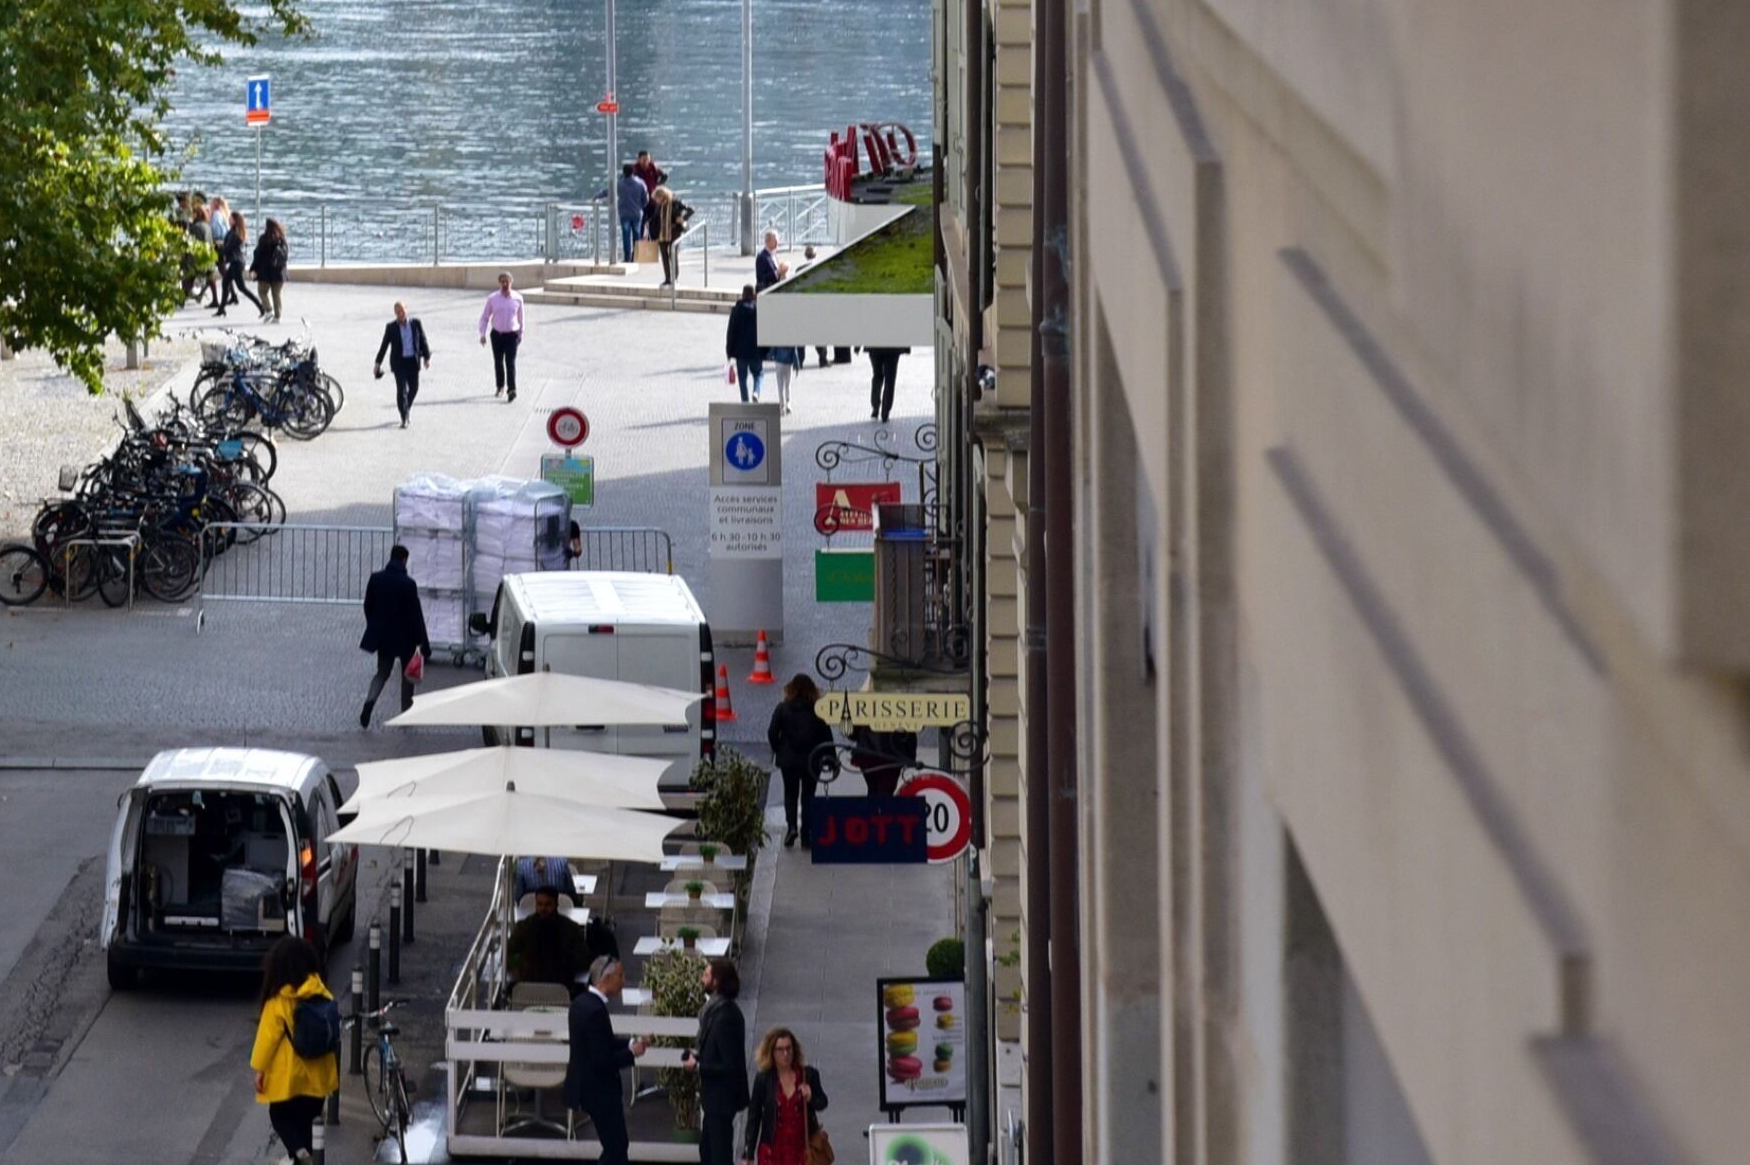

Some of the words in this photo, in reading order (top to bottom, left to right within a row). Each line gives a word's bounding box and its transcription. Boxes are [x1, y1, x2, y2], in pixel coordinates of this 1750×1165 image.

[734, 421, 755, 431] ZONE
[742, 494, 778, 503] services
[717, 505, 775, 514] communaux
[719, 516, 728, 524] et
[731, 515, 774, 525] livraisons
[817, 813, 922, 847] JOTT
